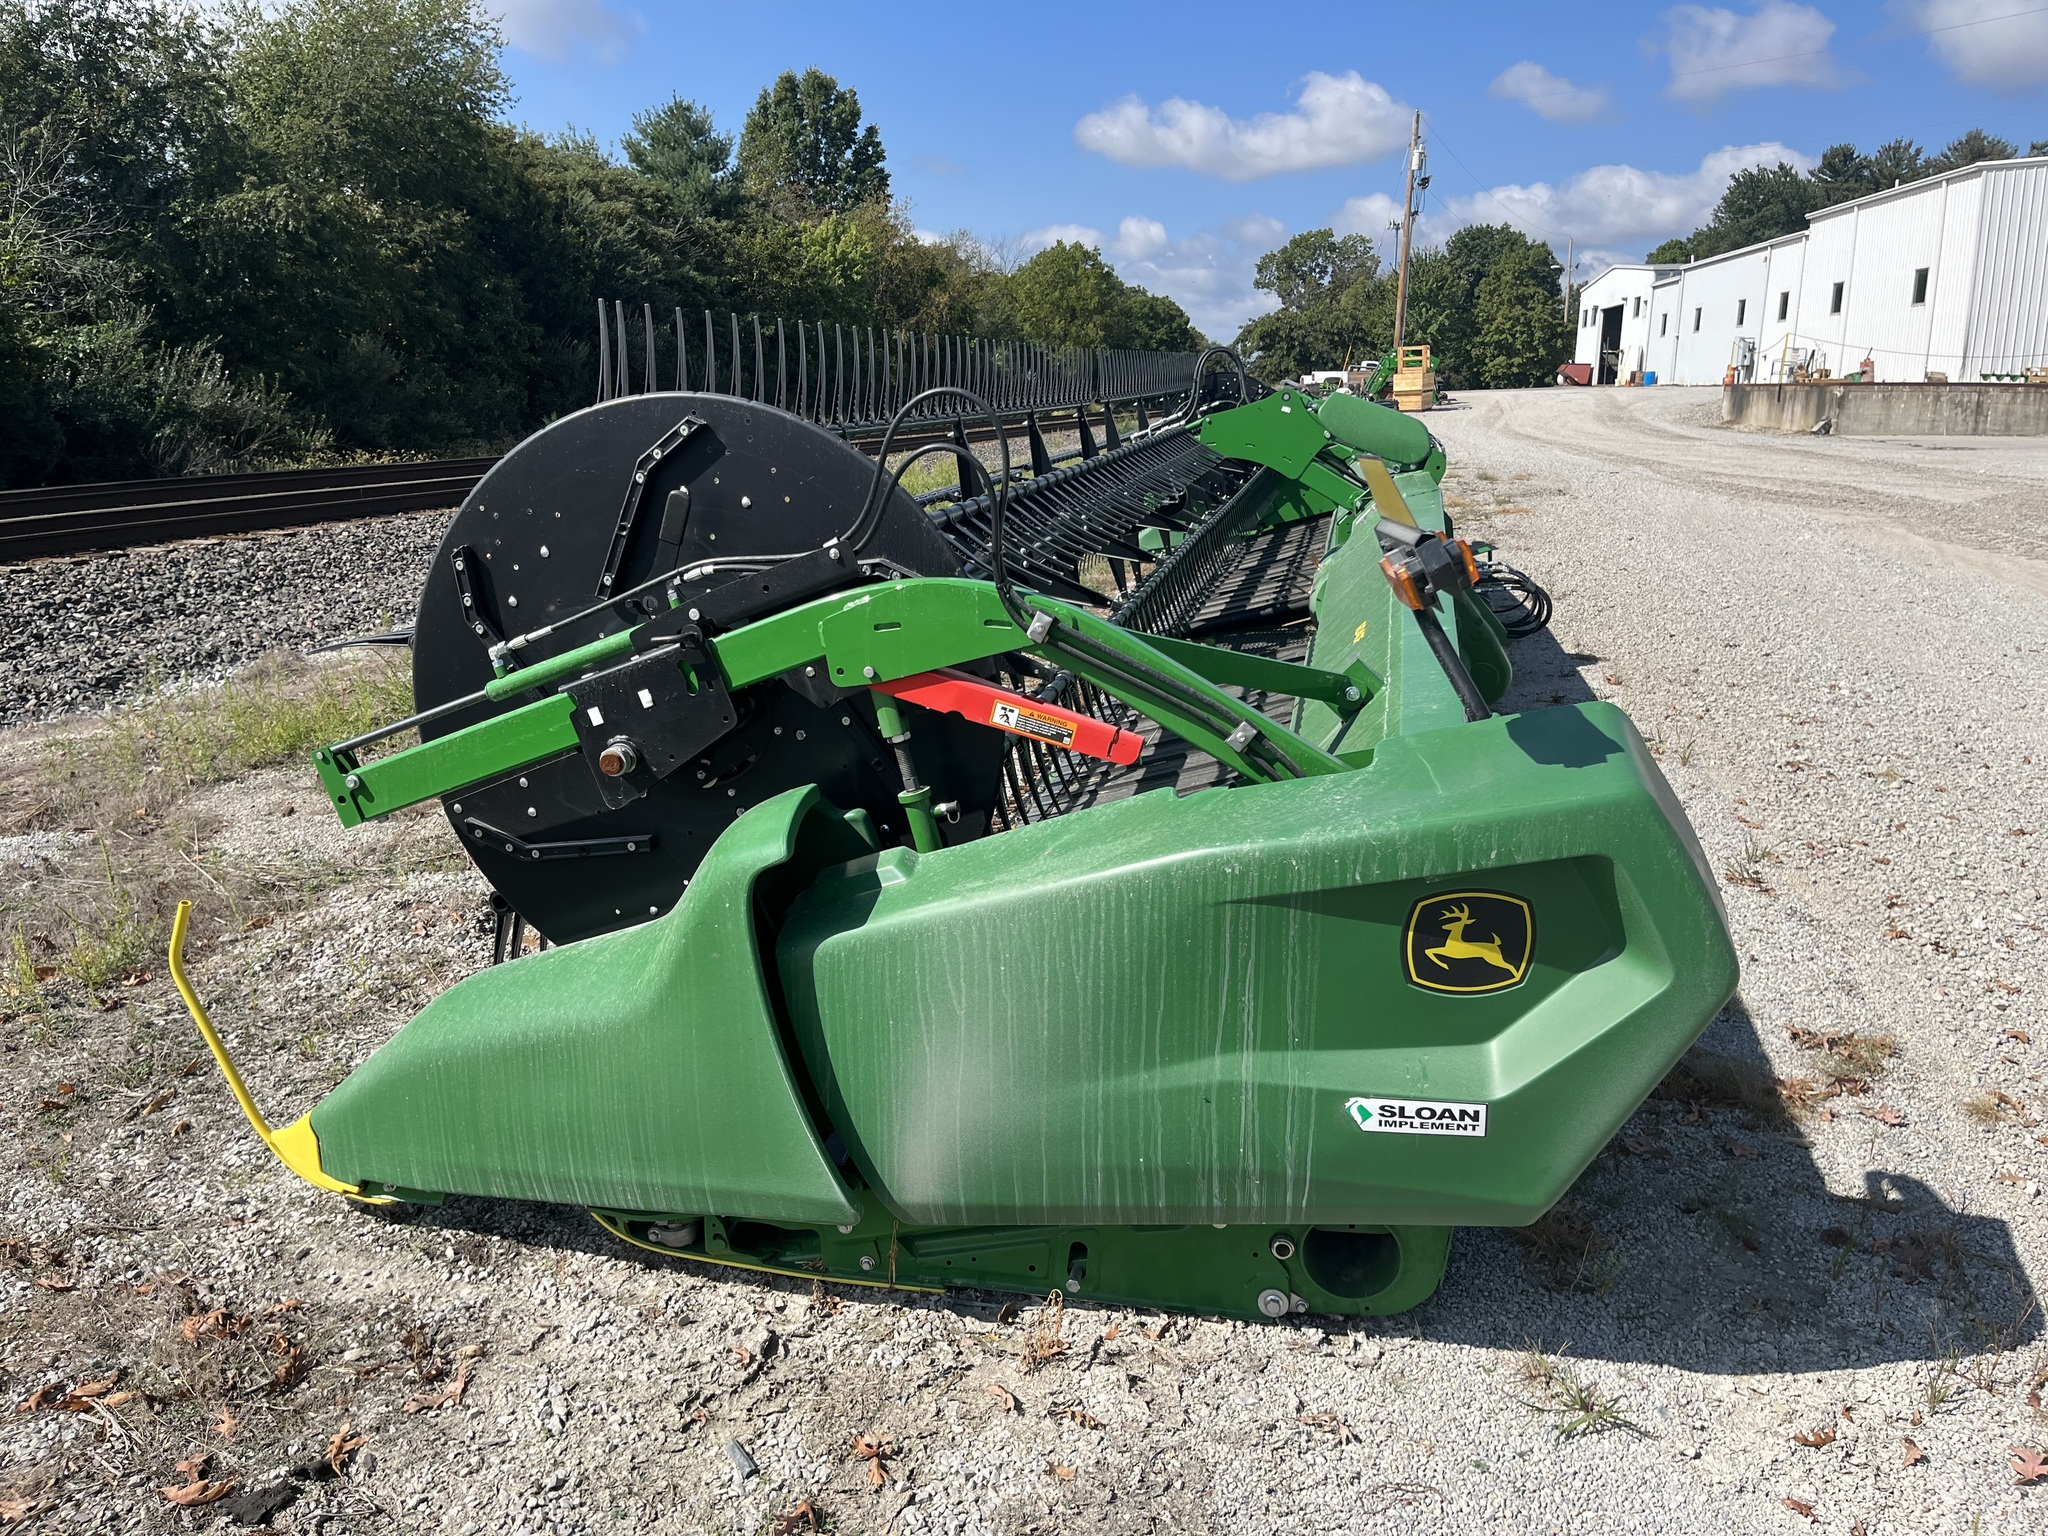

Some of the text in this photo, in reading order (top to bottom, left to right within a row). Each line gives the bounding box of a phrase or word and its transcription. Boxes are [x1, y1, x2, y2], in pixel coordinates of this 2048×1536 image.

[1037, 714, 1068, 727] WARNING
[1378, 1105, 1480, 1122] SLOAN
[1378, 1120, 1480, 1131] IMPLEMENT
